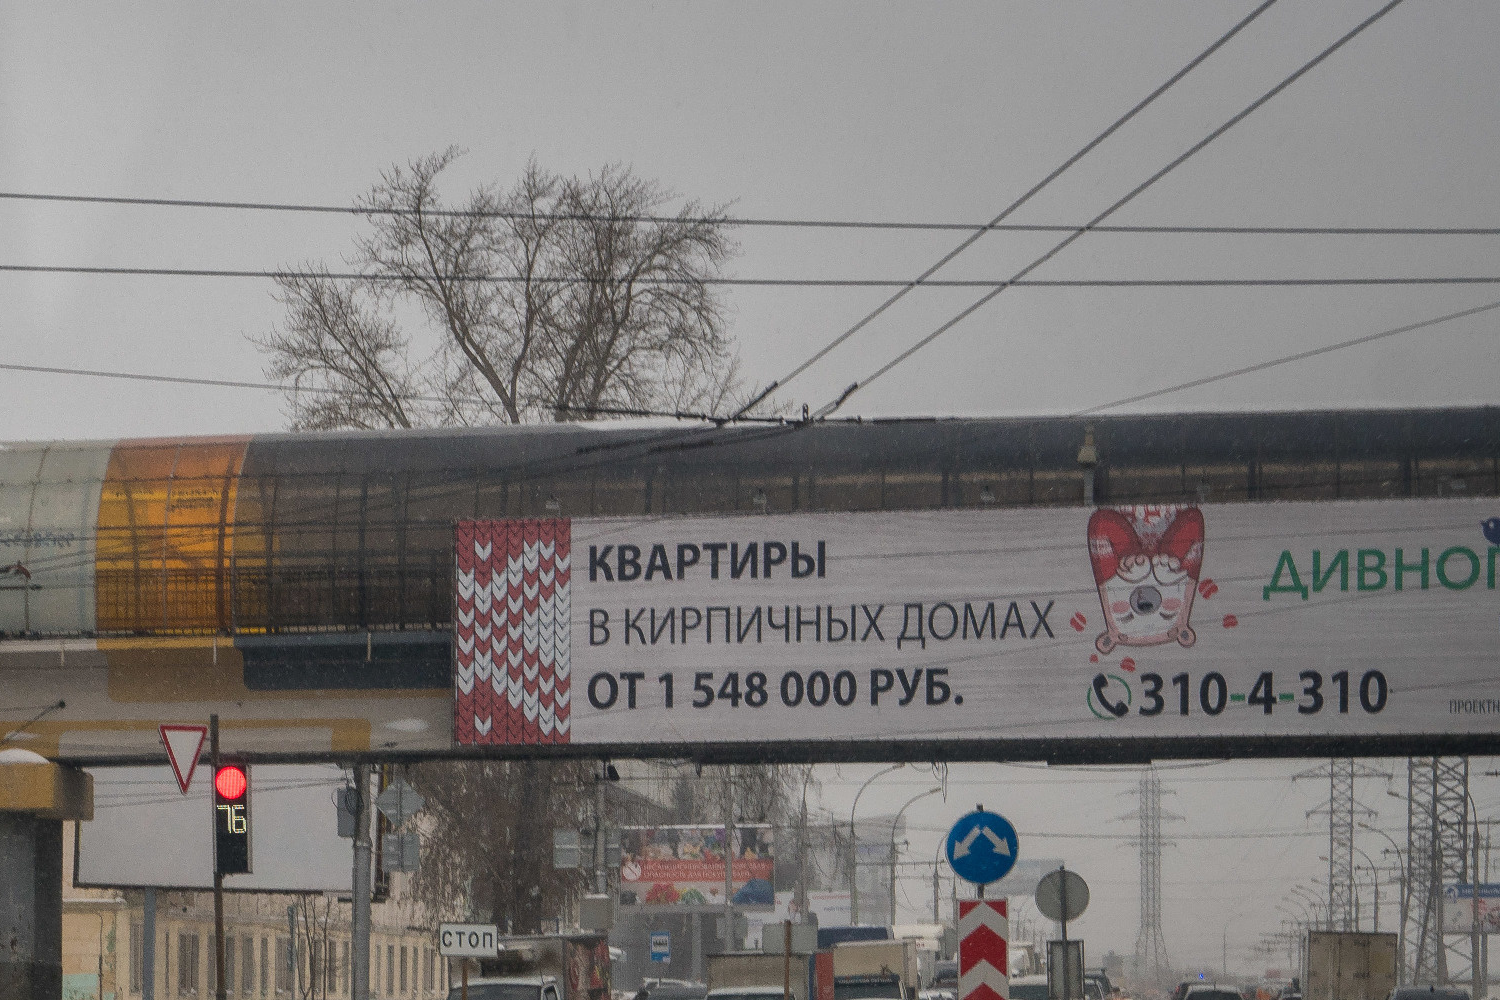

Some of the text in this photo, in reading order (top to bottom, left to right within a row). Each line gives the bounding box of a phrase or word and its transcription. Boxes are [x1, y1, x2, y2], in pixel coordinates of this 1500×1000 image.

[588, 540, 826, 582] КВАРТИРЫ
[589, 600, 1055, 649] В КИРПИЧНЫХ ДОМАХ
[587, 668, 965, 710] ОТ 1 548 000 РУБ.
[1139, 670, 1388, 716] 310-4-310
[217, 804, 247, 833] 76
[441, 930, 493, 949] СТОП
